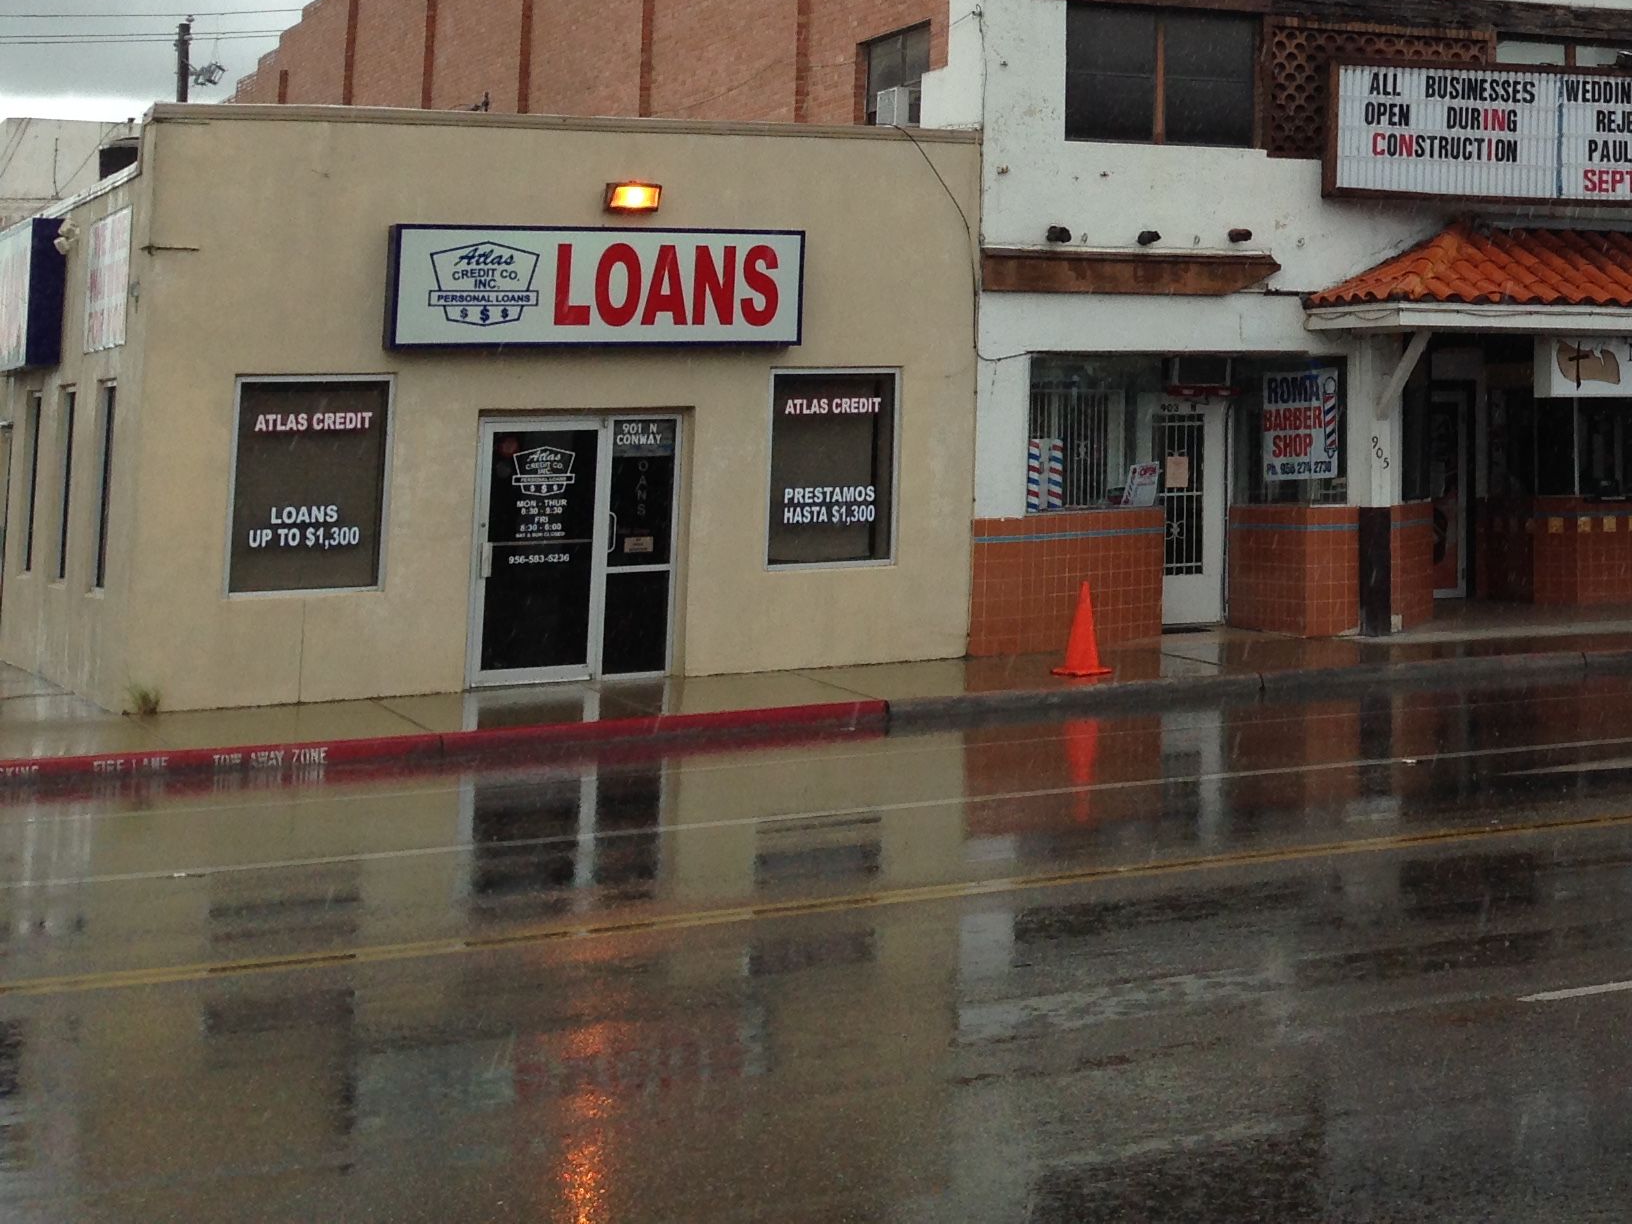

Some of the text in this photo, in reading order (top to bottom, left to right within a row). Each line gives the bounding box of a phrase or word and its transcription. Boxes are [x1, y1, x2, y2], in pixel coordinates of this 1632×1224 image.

[1370, 73, 1536, 103] ALL BUSINESSES
[1365, 102, 1517, 132] OPEN DURING
[1372, 132, 1518, 162] CONSTRUCTION
[1588, 139, 1632, 163] PAUL
[454, 247, 515, 266] Atlas
[452, 268, 520, 281] CREDIT CO.
[474, 279, 500, 289] INC.
[553, 242, 779, 327] LOANS
[437, 294, 530, 303] PERSONAL LOANS
[1267, 375, 1320, 404] ROMA
[785, 397, 881, 414] ATLAS CREDIT
[254, 412, 373, 432] ATLAS CREDIT
[622, 423, 657, 434] 901 N
[1263, 406, 1323, 432] BARBER
[616, 434, 662, 445] CONWAY
[1272, 433, 1313, 458] SHOP
[1371, 436, 1390, 469] 905
[517, 499, 567, 508] MON THUR
[784, 486, 875, 504] PRESTAMOS
[271, 505, 338, 524] LOANS
[784, 504, 875, 526] HASTA $1,300
[249, 527, 360, 549] UP TO $1,300
[213, 753, 242, 767] TOW
[250, 750, 284, 767] AWAY
[292, 747, 329, 765] ZONE
